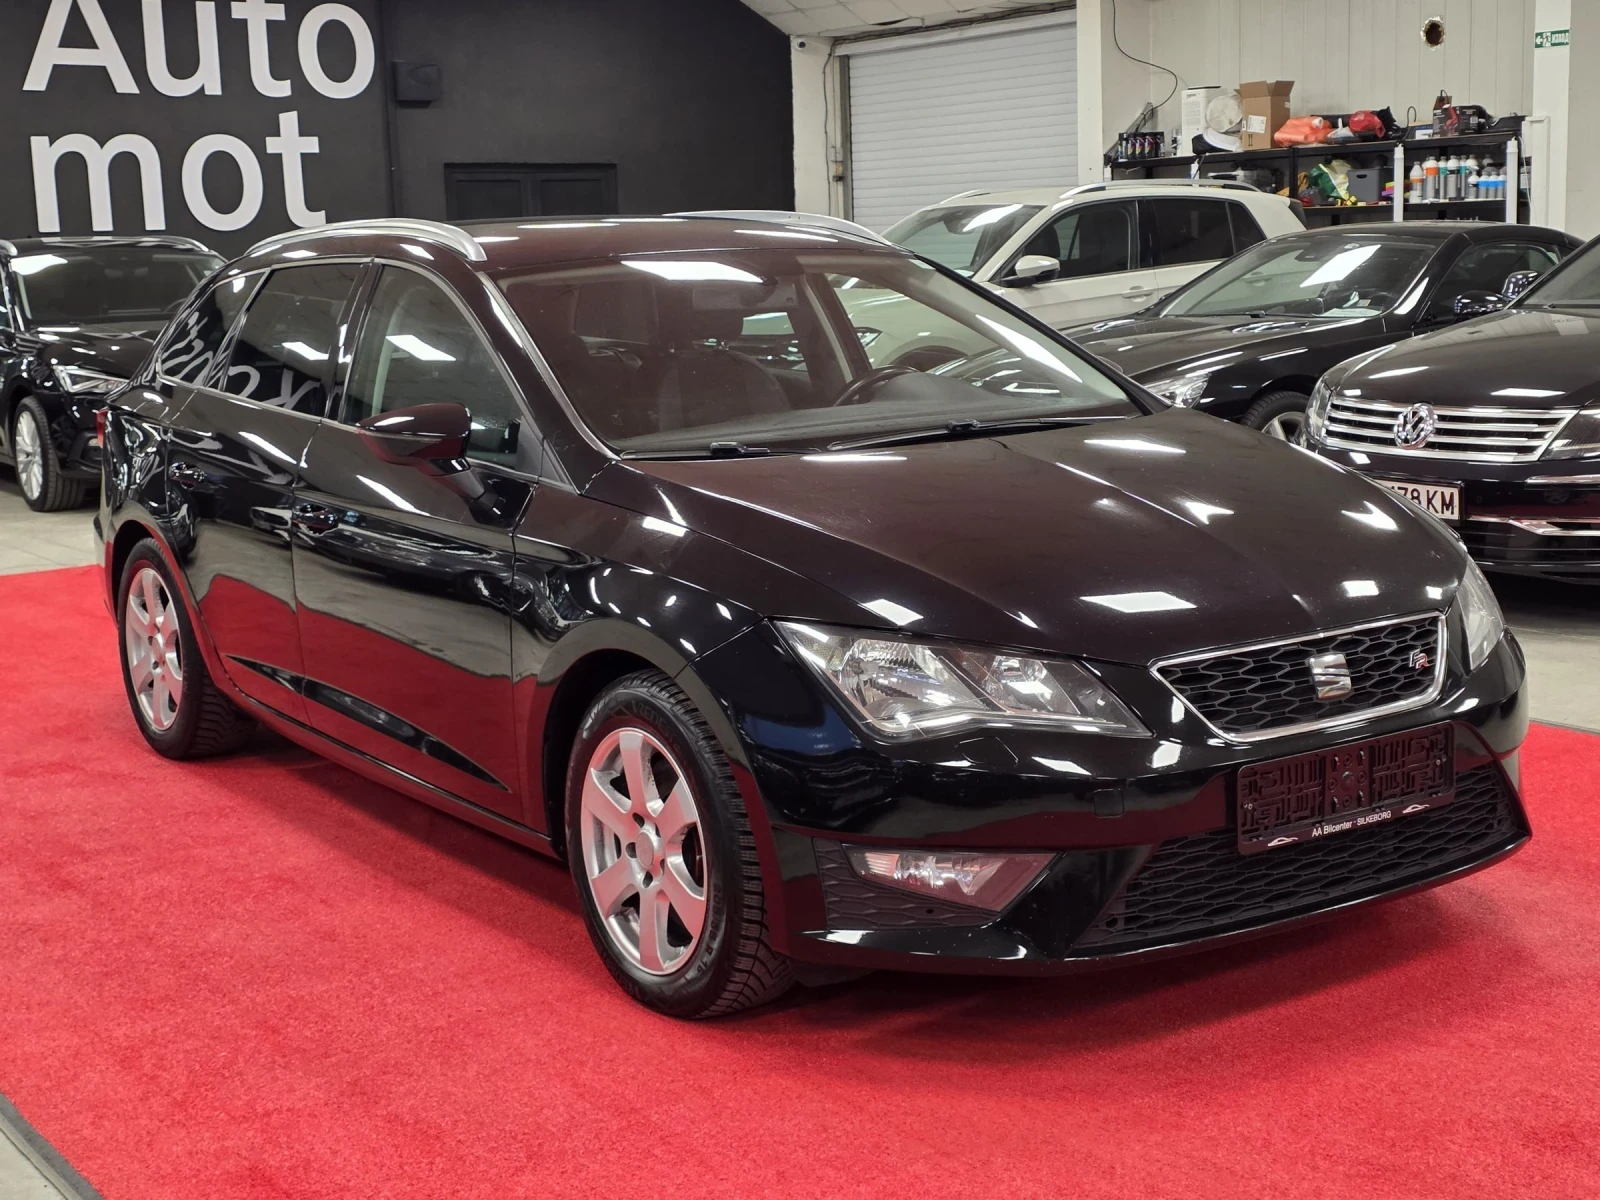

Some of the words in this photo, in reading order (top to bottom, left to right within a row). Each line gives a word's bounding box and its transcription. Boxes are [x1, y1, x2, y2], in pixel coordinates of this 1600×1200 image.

[22, 0, 375, 99] Auto
[30, 110, 326, 233] mot
[1426, 489, 1455, 515] KM
[1409, 648, 1430, 669] FR
[1311, 827, 1323, 838] AA
[1323, 820, 1353, 835] Bilcenter
[1356, 810, 1392, 826] SILKEBORG
